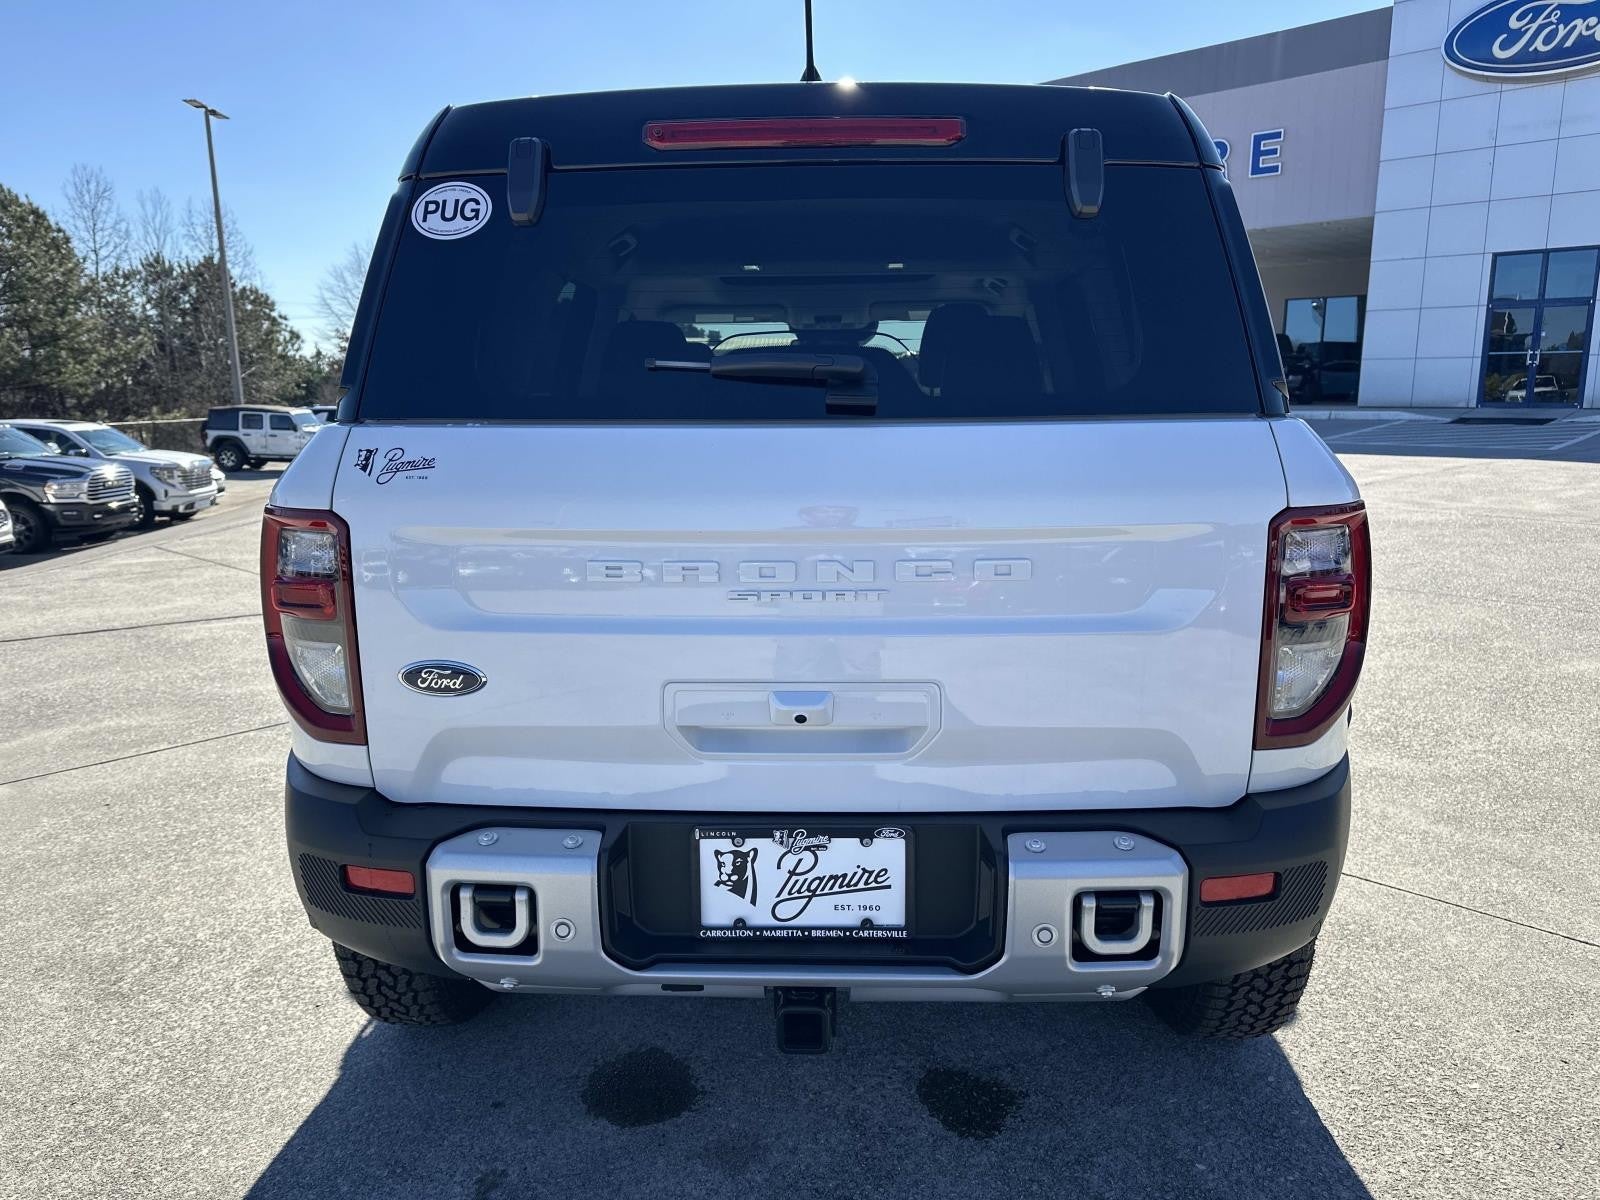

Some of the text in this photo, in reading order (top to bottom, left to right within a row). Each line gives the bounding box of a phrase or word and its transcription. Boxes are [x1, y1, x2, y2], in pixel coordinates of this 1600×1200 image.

[1491, 0, 1600, 60] For
[421, 197, 481, 223] PUG
[376, 447, 436, 485] Pugmire
[586, 558, 1032, 583] BRONCO
[727, 589, 889, 602] SPORT
[417, 668, 464, 689] Ford
[791, 828, 830, 854] Pugmire
[880, 829, 900, 838] Ford
[771, 849, 892, 923] Pugmire
[699, 929, 908, 938] CARROLLTON MARIETTA BREMEN CARTERSVILLE
